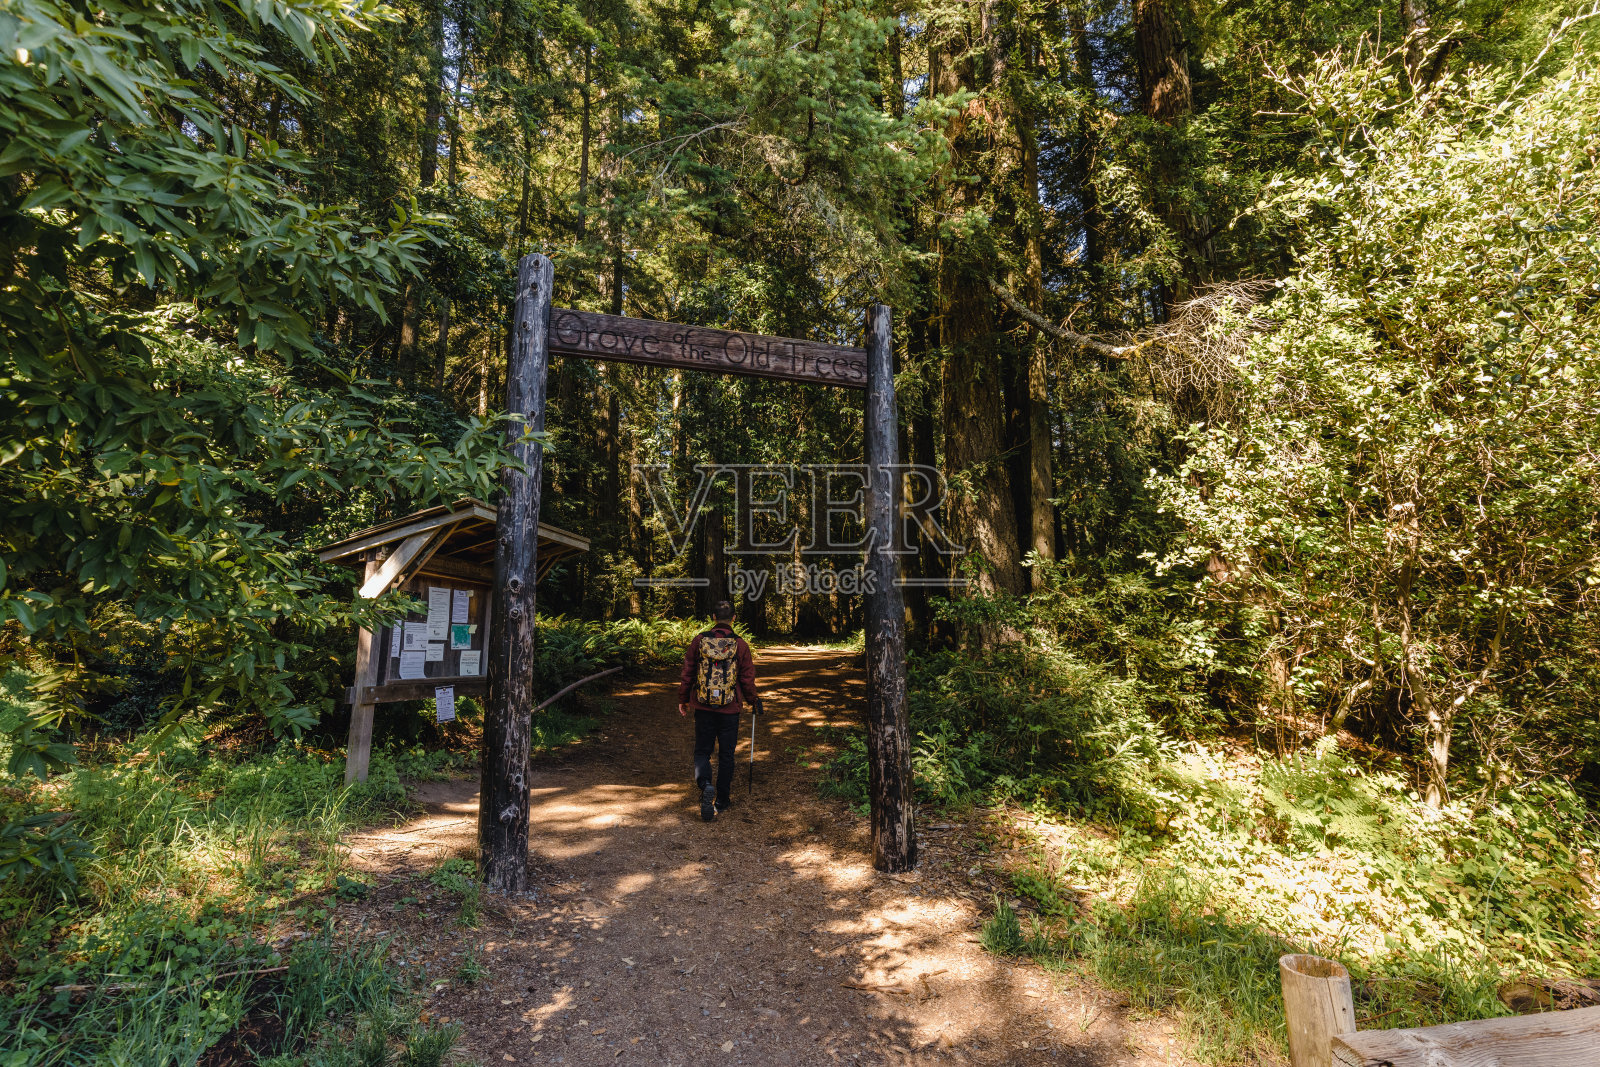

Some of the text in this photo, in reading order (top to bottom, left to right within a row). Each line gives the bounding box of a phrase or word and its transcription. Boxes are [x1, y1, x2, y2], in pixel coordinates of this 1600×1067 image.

[555, 313, 865, 380] Grove of the Old Trees
